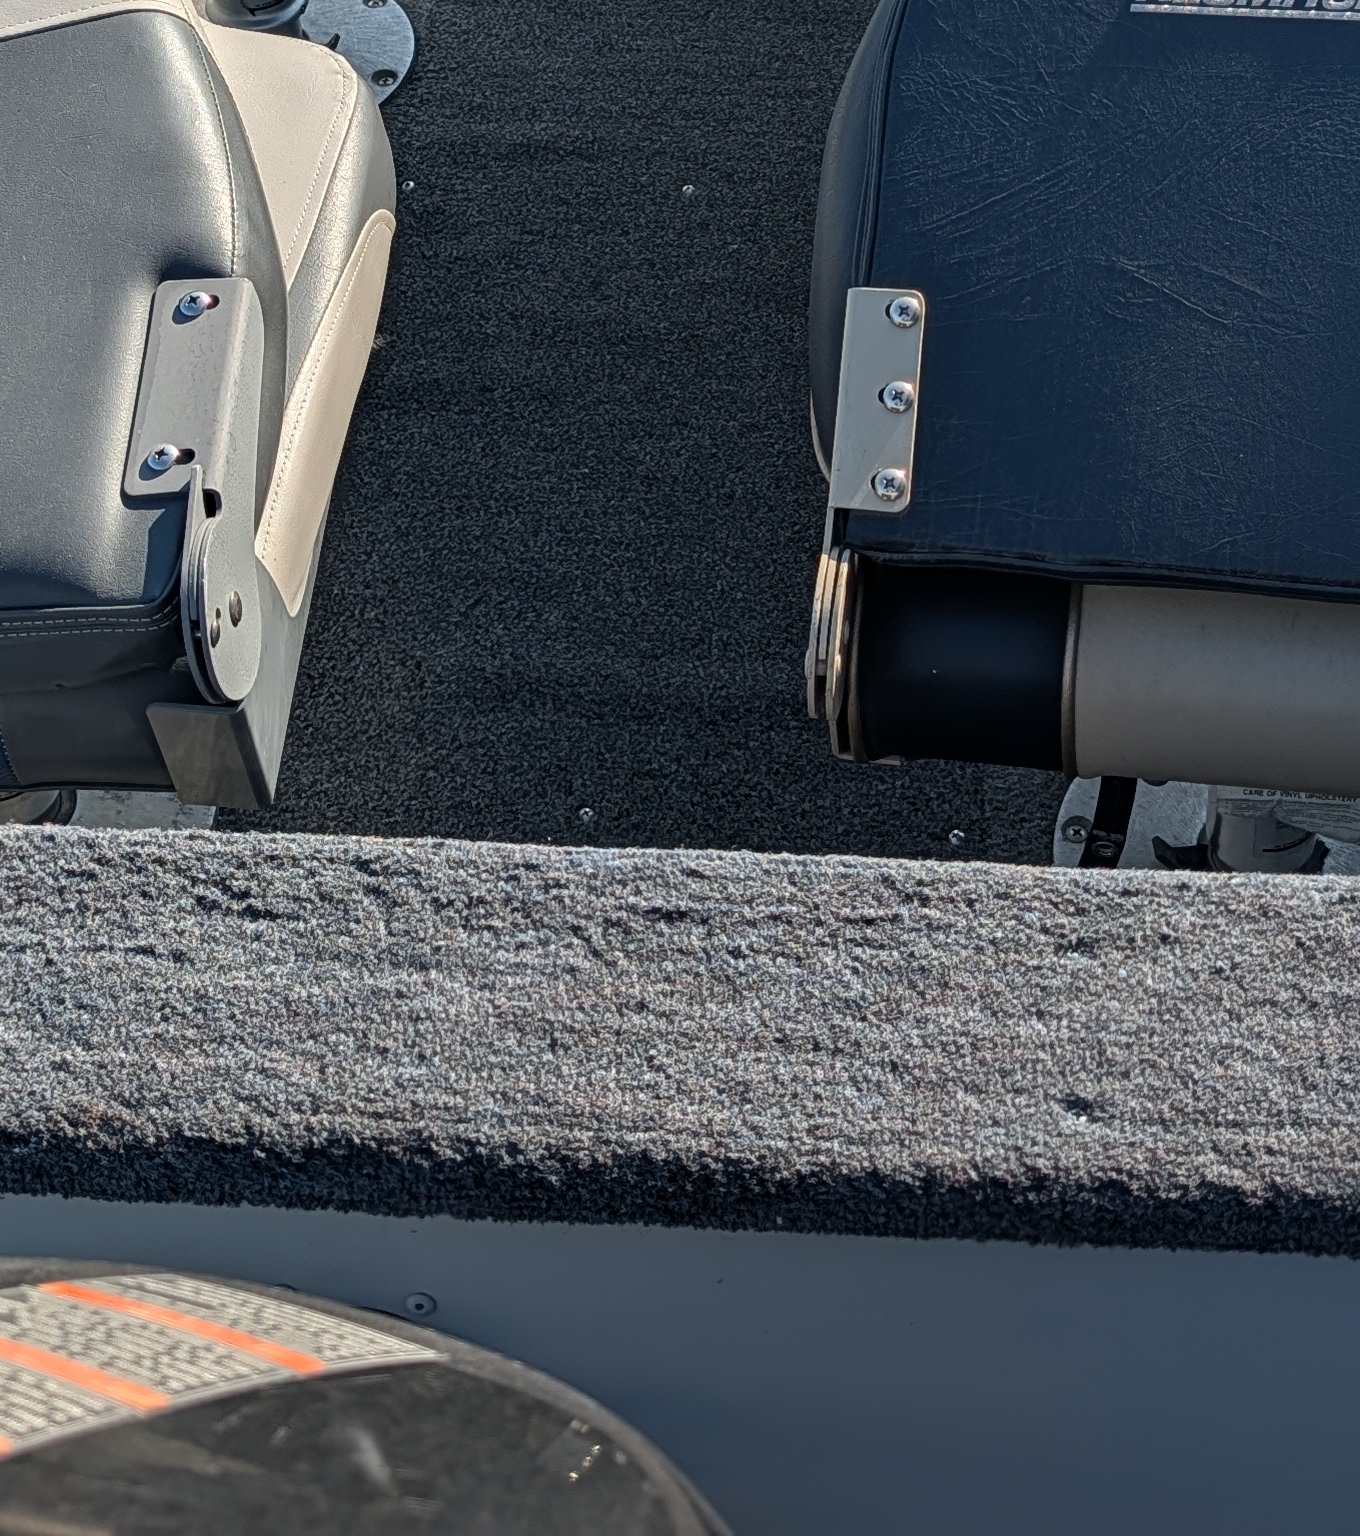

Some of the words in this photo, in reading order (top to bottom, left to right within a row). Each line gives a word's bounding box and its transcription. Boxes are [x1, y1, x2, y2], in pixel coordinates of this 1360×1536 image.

[1243, 788, 1264, 797] CARE
[1280, 790, 1302, 799] VINYL
[1305, 792, 1358, 803] UPHOLSTERY
